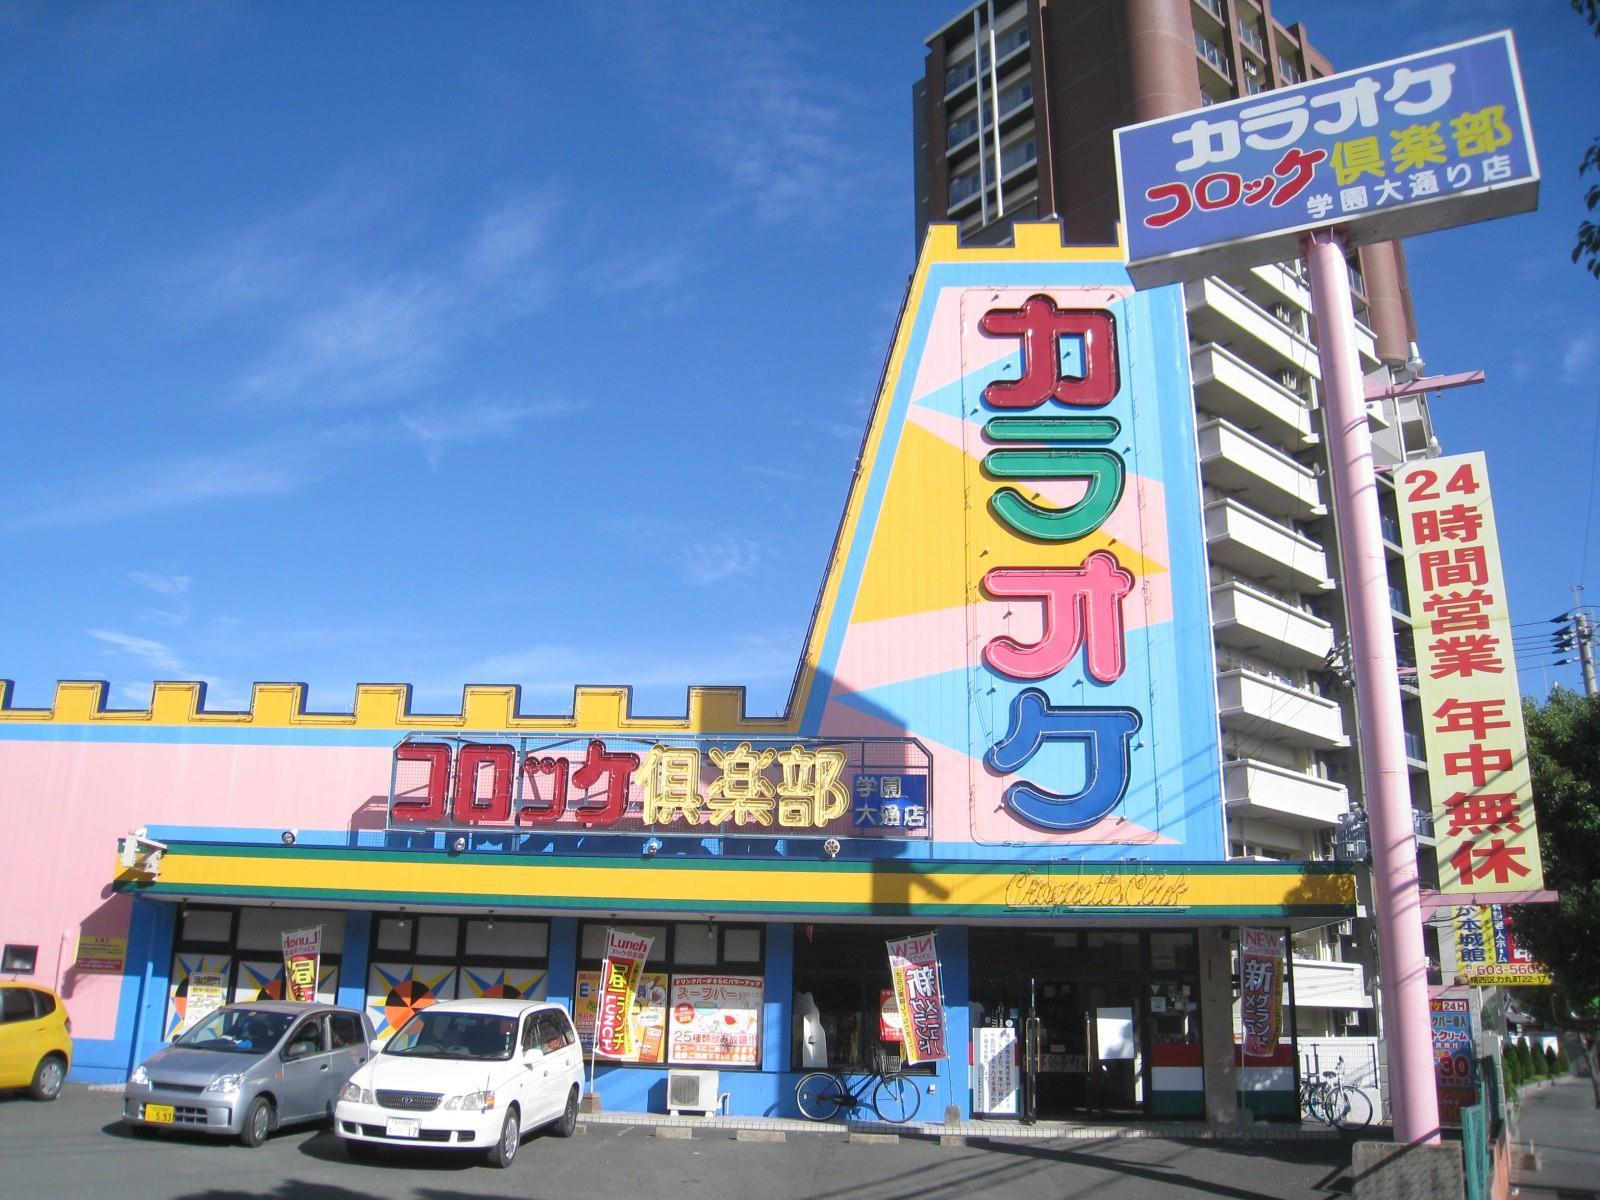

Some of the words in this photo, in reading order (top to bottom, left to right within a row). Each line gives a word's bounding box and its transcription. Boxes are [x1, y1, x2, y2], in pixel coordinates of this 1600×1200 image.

[1171, 63, 1455, 172] カラオケ
[1306, 156, 1511, 219] 学園大通り店
[981, 294, 1143, 831] カラオケ
[1404, 463, 1505, 679] 24時間営業
[856, 776, 901, 799] 学園
[1433, 698, 1532, 886] 年中無休
[855, 804, 925, 827] 大通店
[610, 933, 648, 953] Lunch
[1246, 931, 1277, 947] NEW
[1245, 959, 1273, 992] 新
[602, 995, 616, 1051] LUNCH
[1443, 1002, 1465, 1011] 24H
